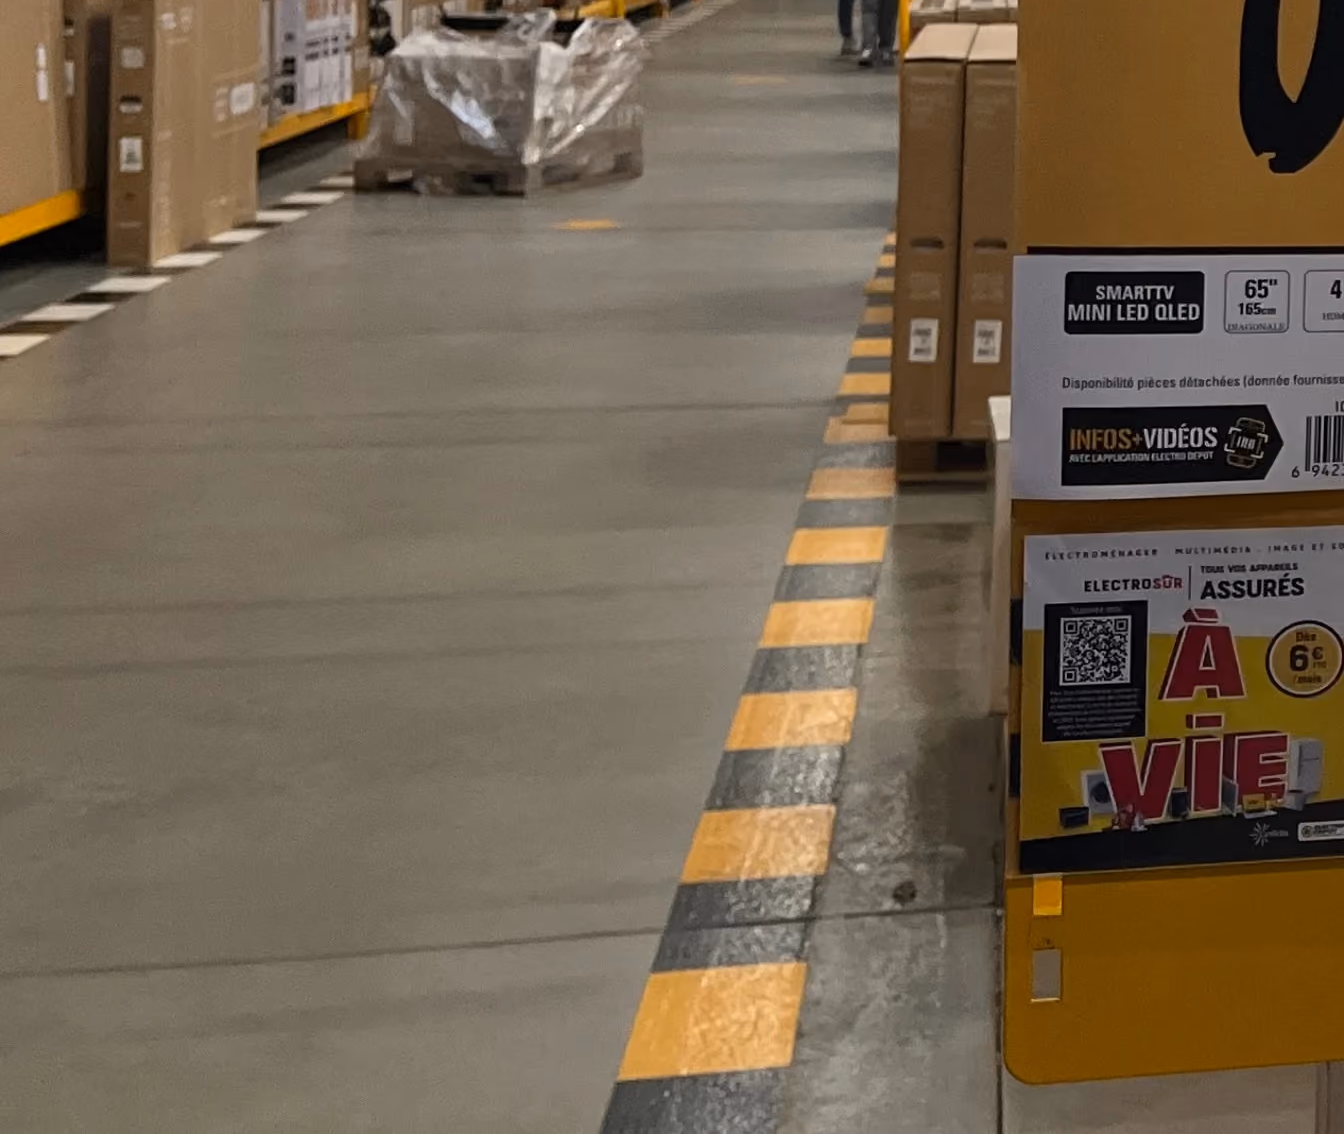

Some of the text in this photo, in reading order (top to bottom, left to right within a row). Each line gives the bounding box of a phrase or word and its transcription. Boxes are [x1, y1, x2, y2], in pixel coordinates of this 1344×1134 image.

[1095, 285, 1175, 300] SMARTTV
[1329, 277, 1342, 300] 4
[1067, 303, 1200, 322] MINI LED QLED
[1062, 376, 1134, 391] Disponibilité
[1137, 376, 1176, 390] pièces
[1179, 375, 1241, 389] détachées
[1243, 374, 1290, 389] (donnée
[1291, 465, 1300, 478] 6
[1200, 573, 1305, 600] ASSURÉS
